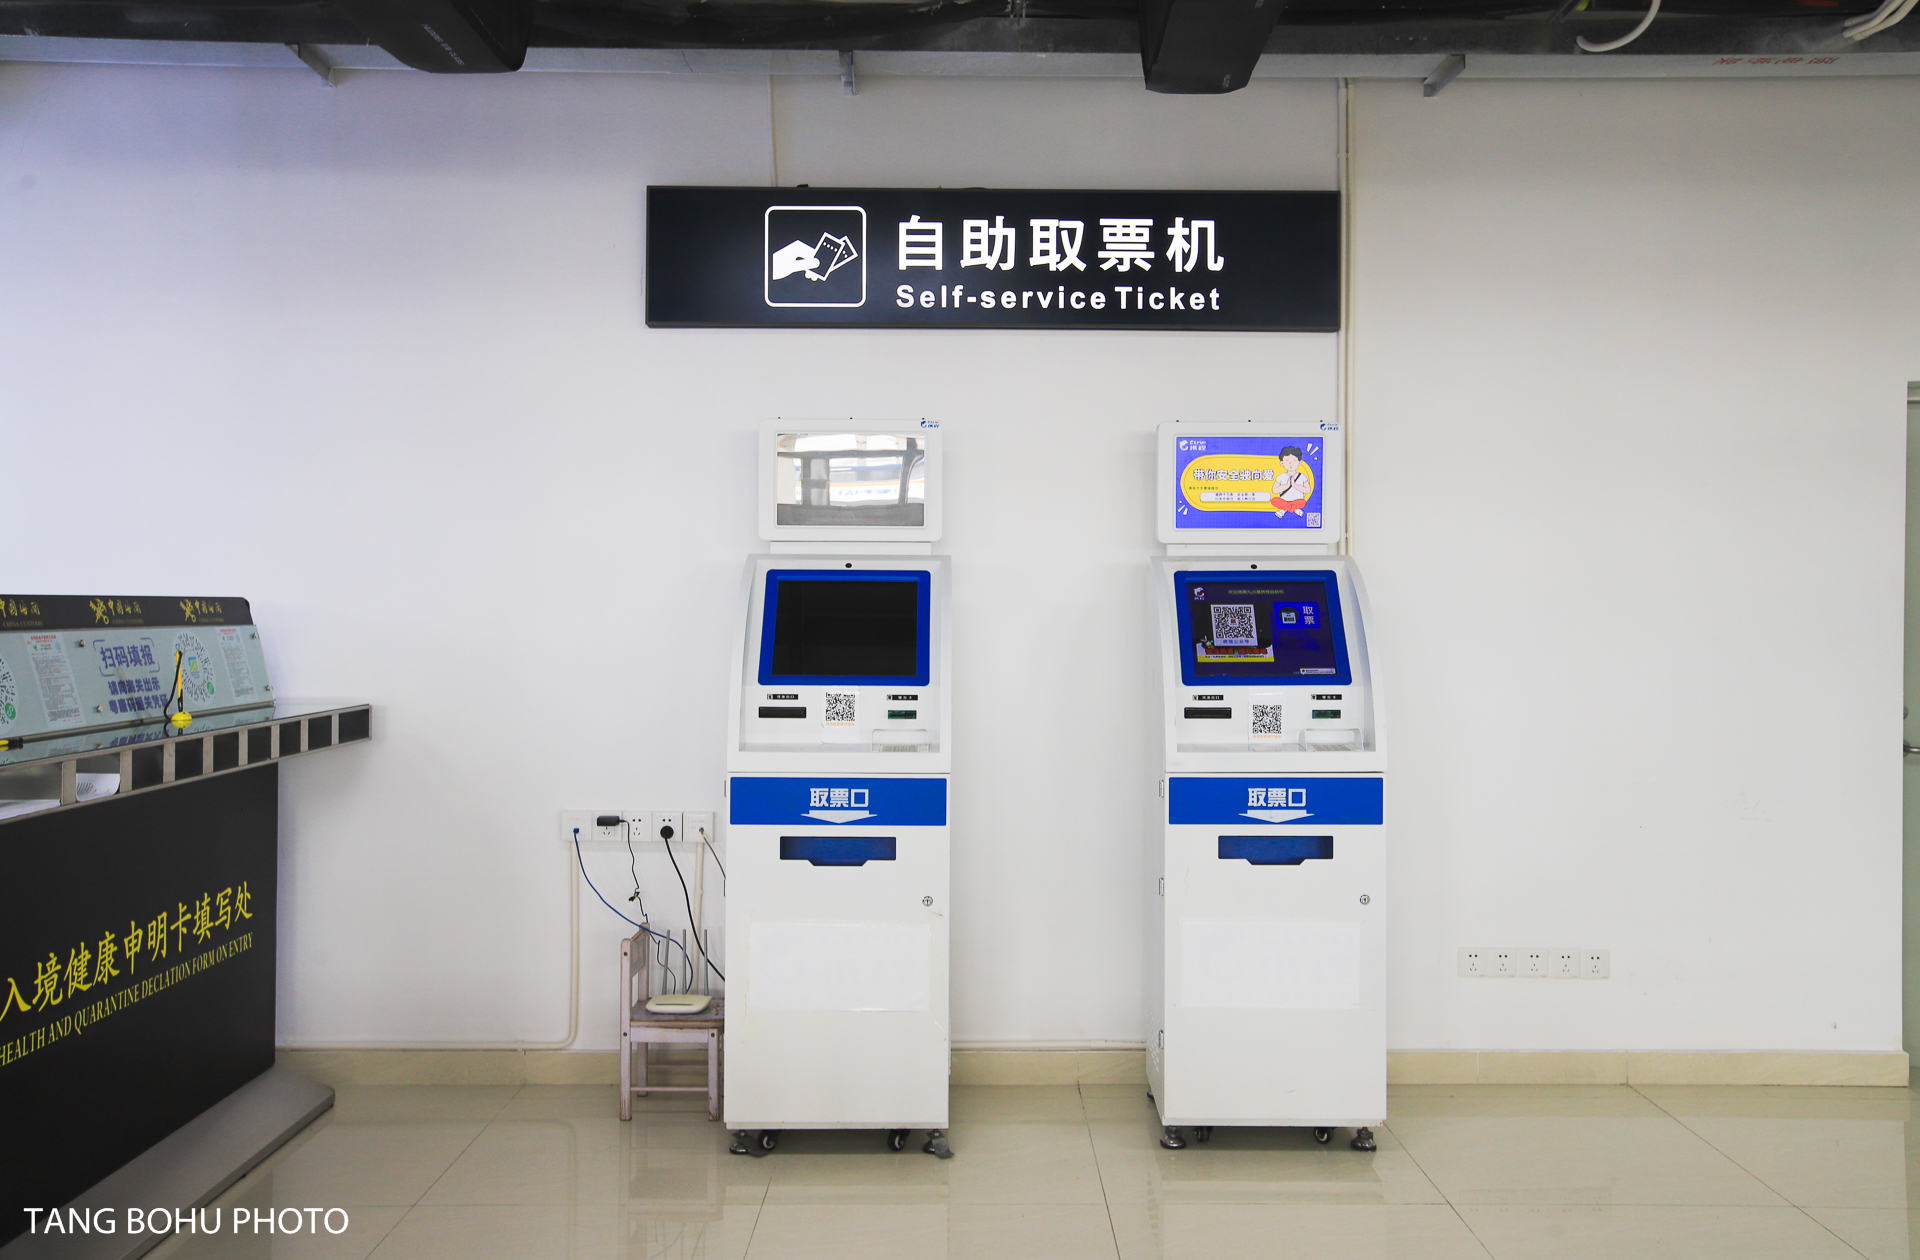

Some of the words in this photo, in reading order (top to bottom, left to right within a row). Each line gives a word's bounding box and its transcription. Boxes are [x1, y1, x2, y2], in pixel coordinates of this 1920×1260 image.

[897, 214, 1225, 273] 自助取票机
[896, 284, 1107, 310] Self-service
[1114, 286, 1220, 311] Ticket
[1193, 468, 1275, 482] 带你安全驶向爱
[1302, 606, 1316, 625] 取票
[100, 644, 155, 669] 扫码填报
[108, 676, 161, 696] 请向海关出示
[809, 787, 869, 808] 取票口
[1247, 787, 1307, 808] 取票口
[0, 880, 253, 1021] 入境健康申明卡填写处
[0, 1027, 46, 1067] HEALTH
[48, 1015, 72, 1044] AND
[74, 984, 140, 1035] QUARANTINE
[141, 962, 192, 1000] DECLATION
[192, 950, 216, 976] FORM
[216, 945, 229, 964] ON
[229, 932, 254, 959] ENTRY
